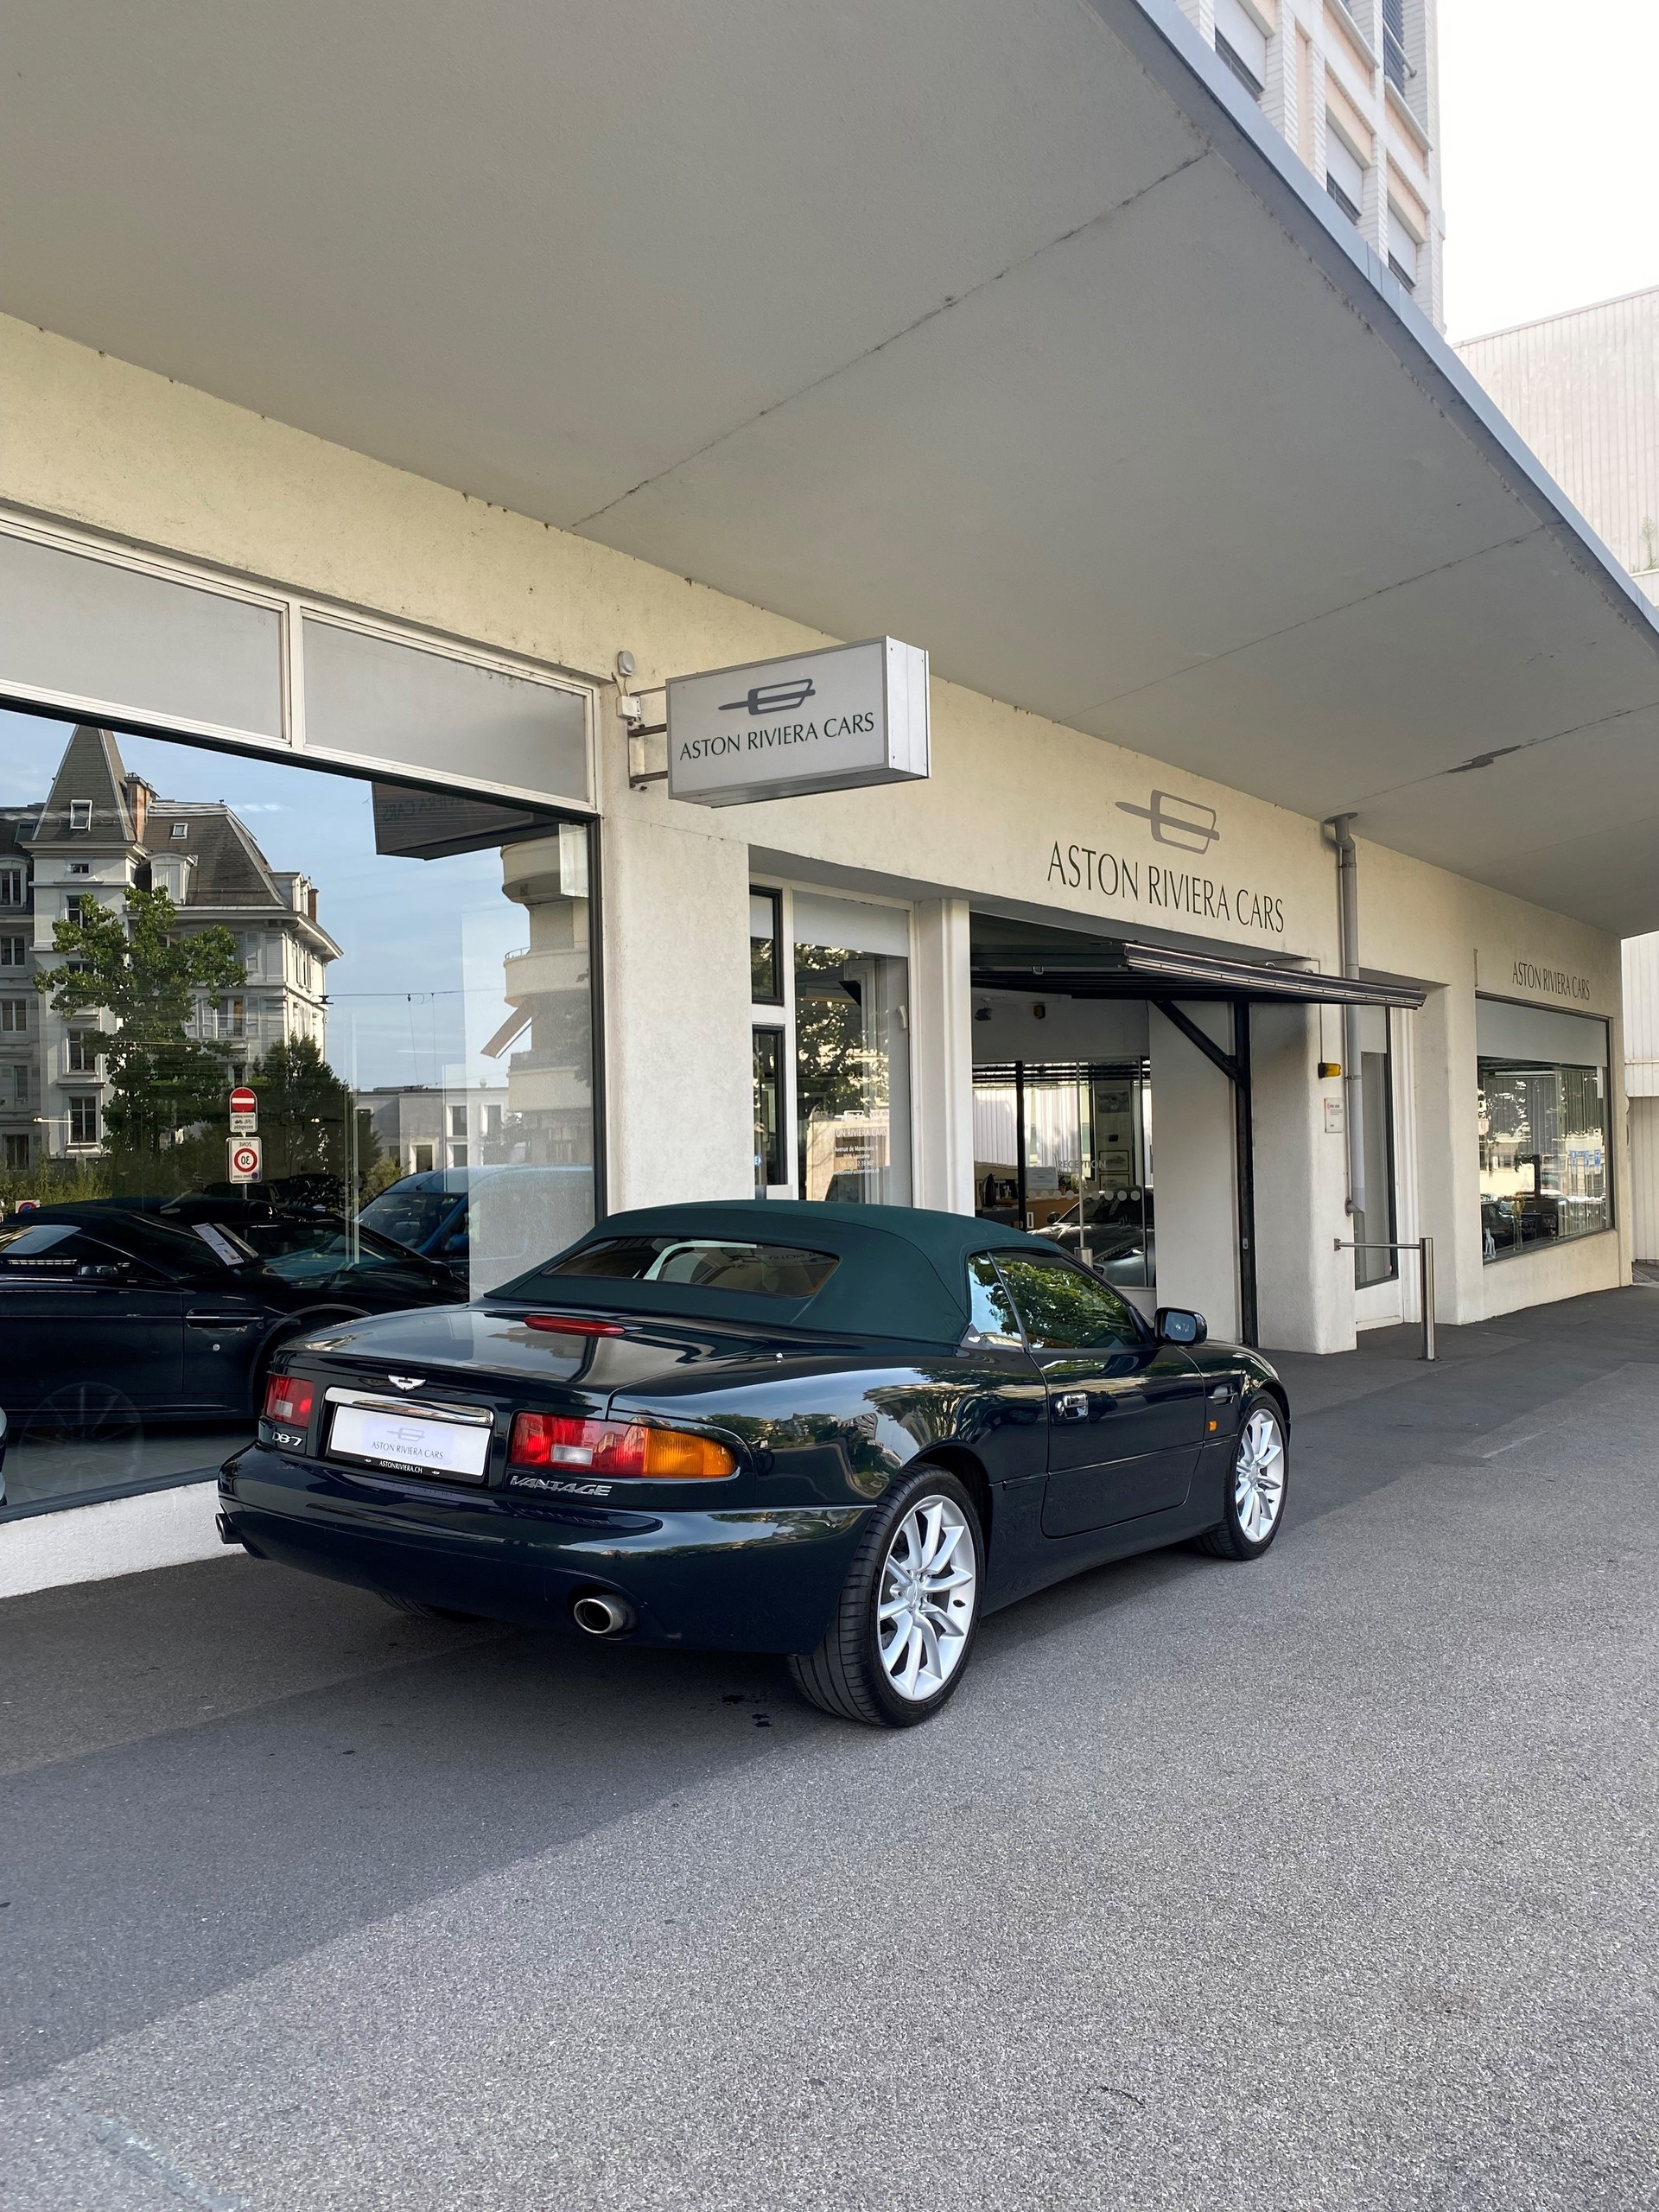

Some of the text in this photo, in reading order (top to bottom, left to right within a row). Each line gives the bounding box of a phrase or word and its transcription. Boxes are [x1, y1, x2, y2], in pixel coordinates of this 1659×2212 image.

[680, 712, 874, 760] ASTON RIVIERA CARS
[1047, 841, 1284, 933] ASTON RIVIERA CARS
[1512, 961, 1590, 1001] ASTON RIVIERA CARS
[847, 1128, 870, 1137] RIVIERA
[871, 1127, 887, 1137] CARS
[272, 1431, 303, 1446] DB7
[371, 1441, 444, 1460] ASTON RIVIERA CARS
[378, 1460, 423, 1474] ASTONRIVIERA.CH
[509, 1475, 613, 1497] VANTAGE
